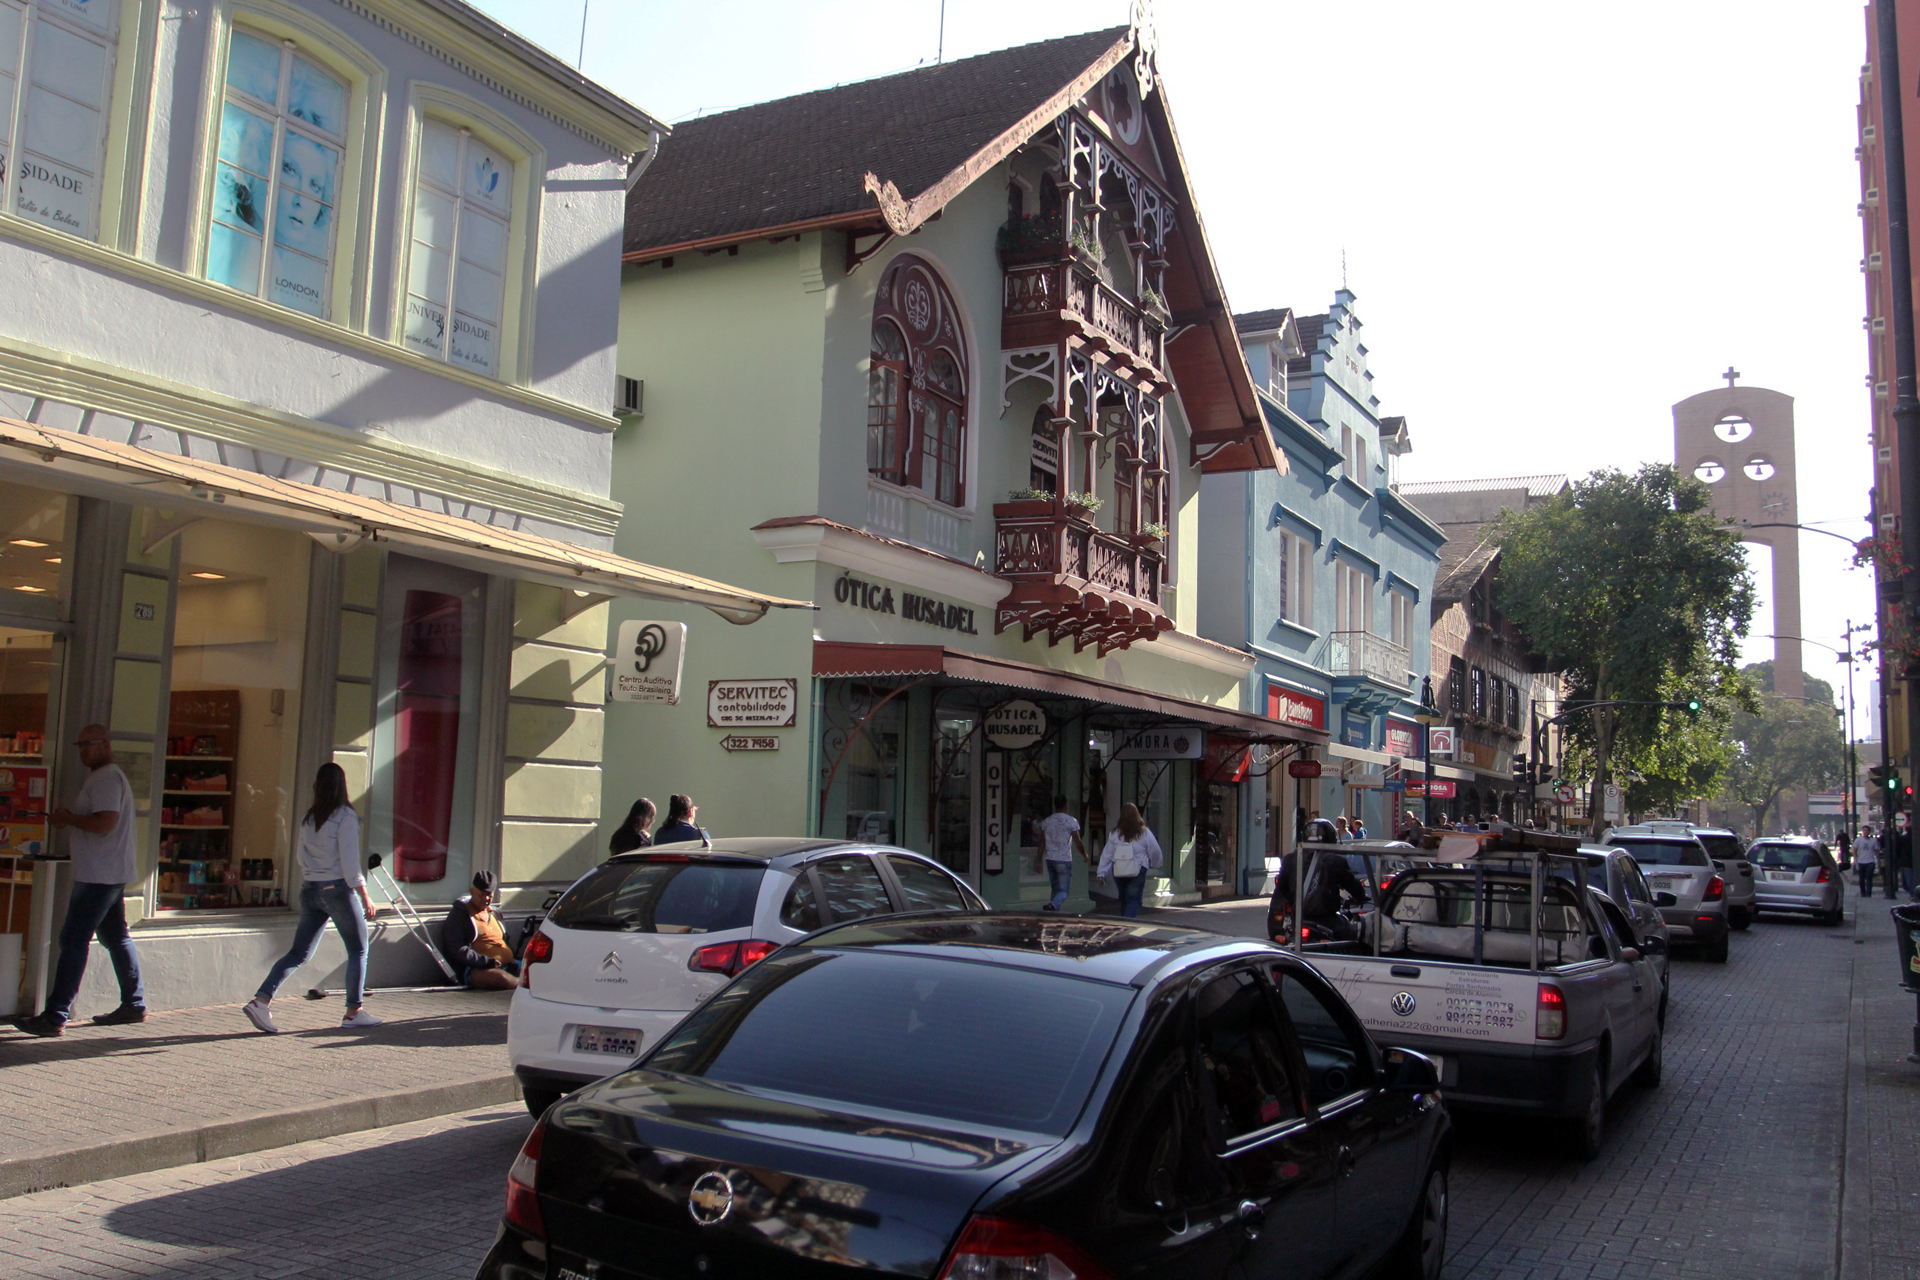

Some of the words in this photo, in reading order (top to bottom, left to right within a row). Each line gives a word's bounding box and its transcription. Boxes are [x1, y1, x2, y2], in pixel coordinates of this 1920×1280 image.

[40, 206, 49, 217] de
[53, 209, 80, 227] Beleza
[275, 277, 319, 299] LONDON
[834, 570, 896, 615] ÓTICA
[902, 592, 979, 636] HUSADEL
[619, 675, 643, 684] Centro
[643, 676, 673, 686] Auditivo
[618, 683, 637, 692] Teuto
[638, 685, 672, 694] Brasileiro
[717, 686, 788, 700] SERVITEC
[717, 702, 787, 712] contabilidade
[987, 724, 1042, 735] HUSADEL
[730, 738, 749, 748] 322
[1125, 735, 1170, 749] AMORA
[987, 765, 1001, 856] OTICA
[1458, 976, 1489, 984] Estruturas
[1466, 971, 1500, 979] Vasculante
[1444, 988, 1466, 996] Cercas
[1466, 983, 1502, 992] Sanfonadas
